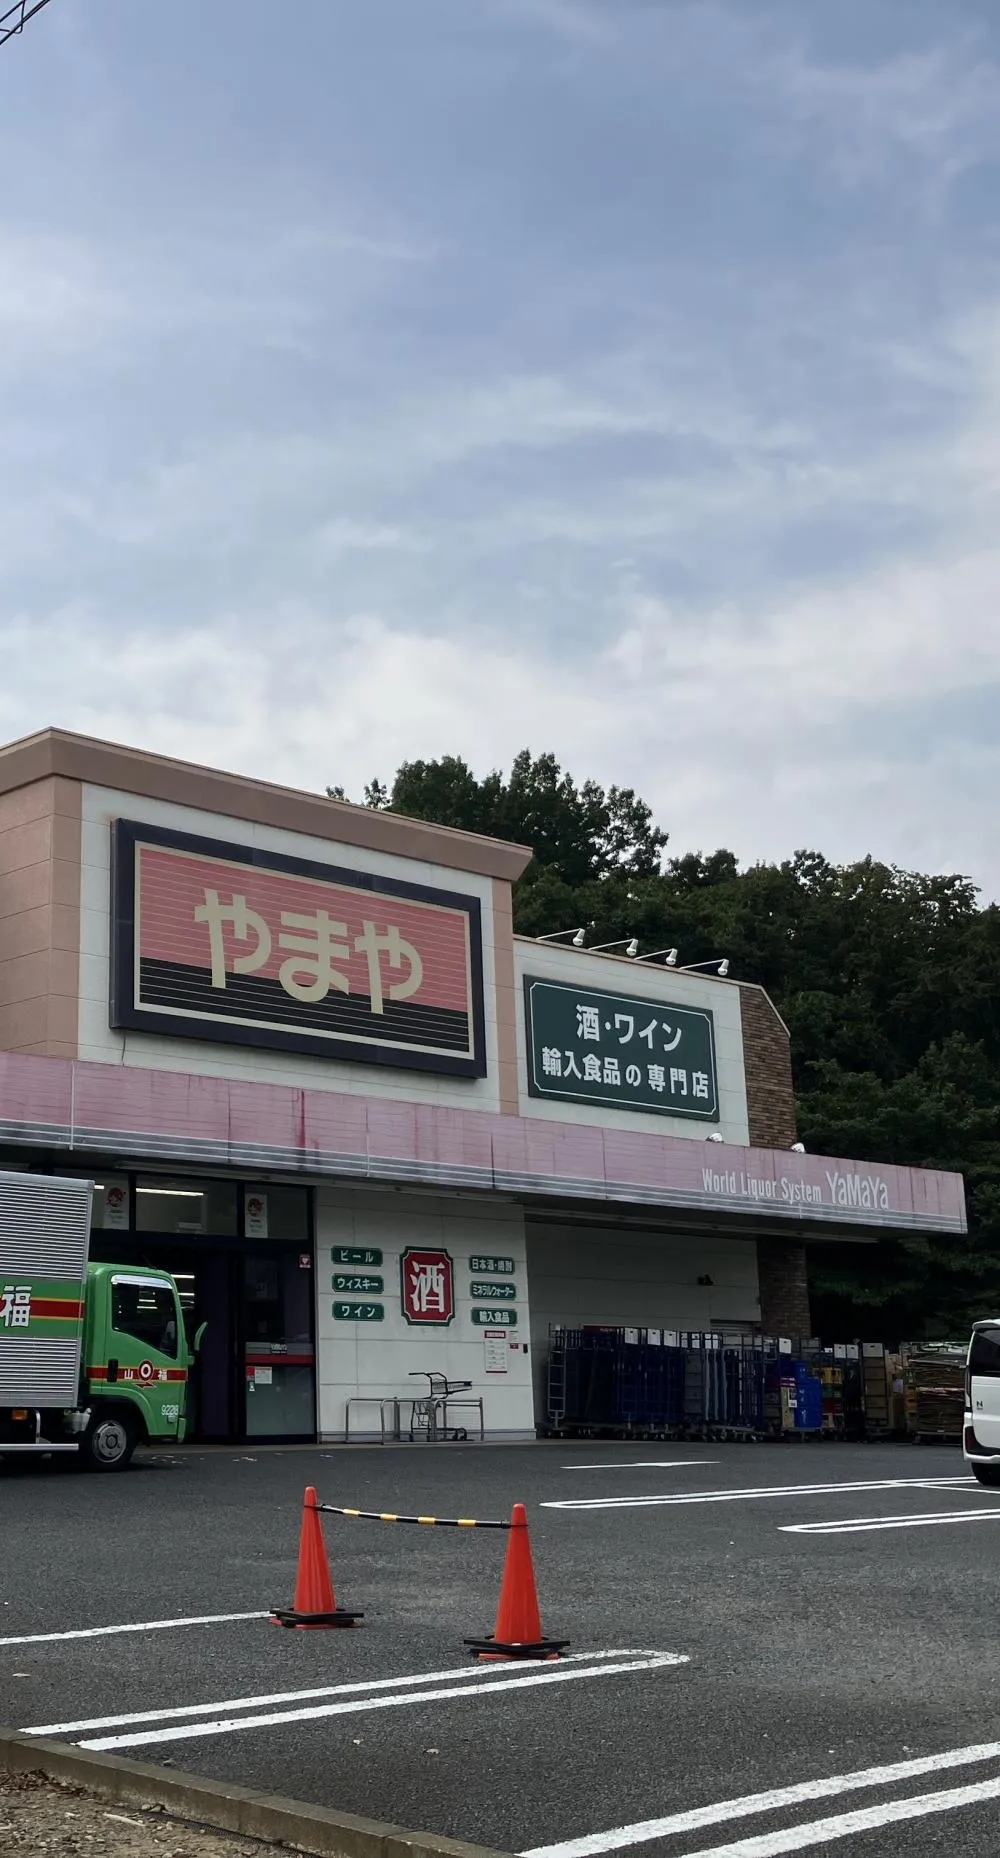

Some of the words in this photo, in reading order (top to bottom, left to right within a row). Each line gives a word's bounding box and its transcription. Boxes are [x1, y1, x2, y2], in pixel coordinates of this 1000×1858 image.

[194, 888, 423, 1015] やまや
[575, 1003, 682, 1051] 酒・ワイン
[541, 1046, 709, 1099] 輸入食品の専門店
[702, 1168, 736, 1194] World
[740, 1172, 777, 1200] Liquor
[781, 1177, 822, 1204] System
[825, 1170, 889, 1209] YaMaYa
[340, 1249, 374, 1263] ビール
[410, 1260, 445, 1313] 酒
[341, 1305, 375, 1318] ワイン
